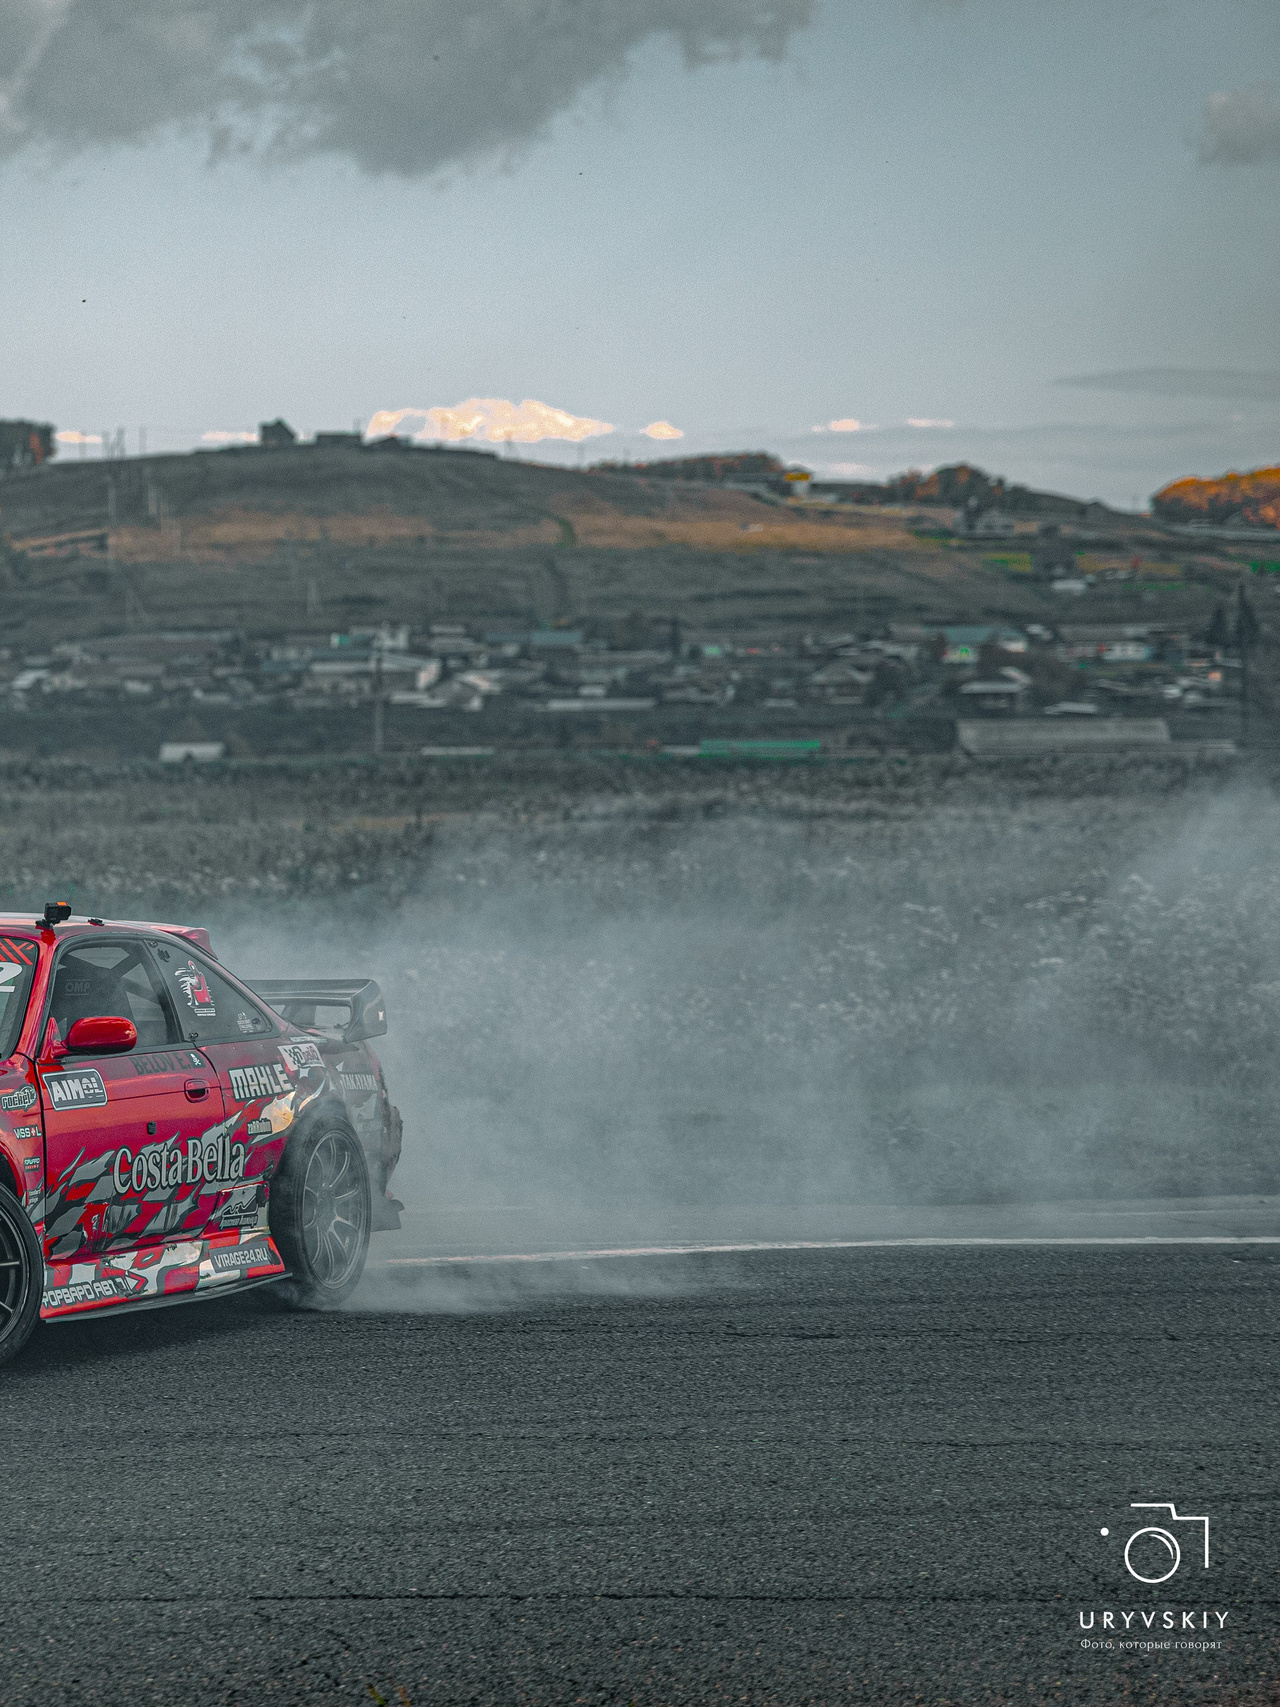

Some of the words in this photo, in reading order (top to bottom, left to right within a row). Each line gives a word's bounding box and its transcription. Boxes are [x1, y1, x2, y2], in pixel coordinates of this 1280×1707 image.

[128, 1054, 175, 1076] BELOV
[51, 1077, 103, 1102] AIMOL
[228, 1063, 294, 1100] MAHLE
[113, 1146, 183, 1194] Costa
[186, 1136, 245, 1183] Bella
[213, 1247, 269, 1269] VIRAGE24.RU
